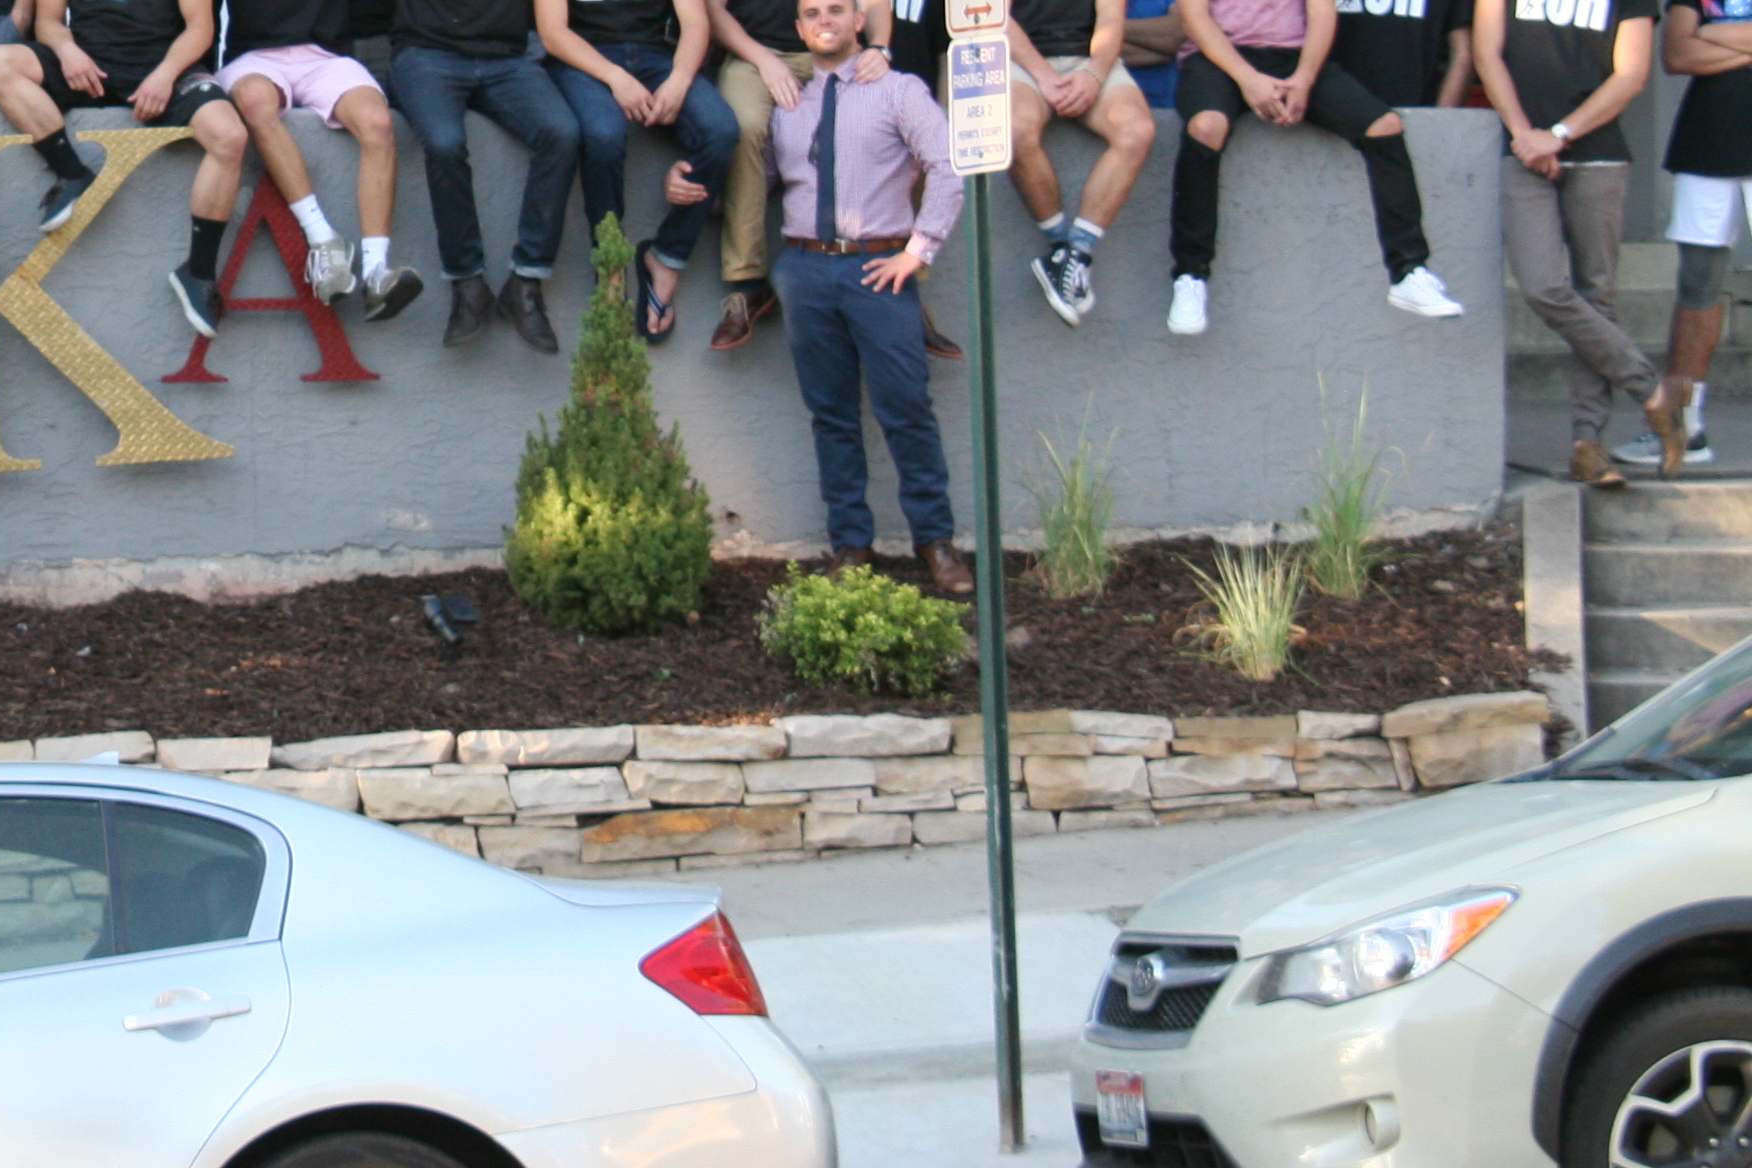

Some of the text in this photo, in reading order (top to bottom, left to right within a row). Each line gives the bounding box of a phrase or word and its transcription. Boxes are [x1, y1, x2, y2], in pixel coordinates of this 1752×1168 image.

[953, 69, 1005, 90] PARKING AREA
[966, 105, 986, 119] AREA
